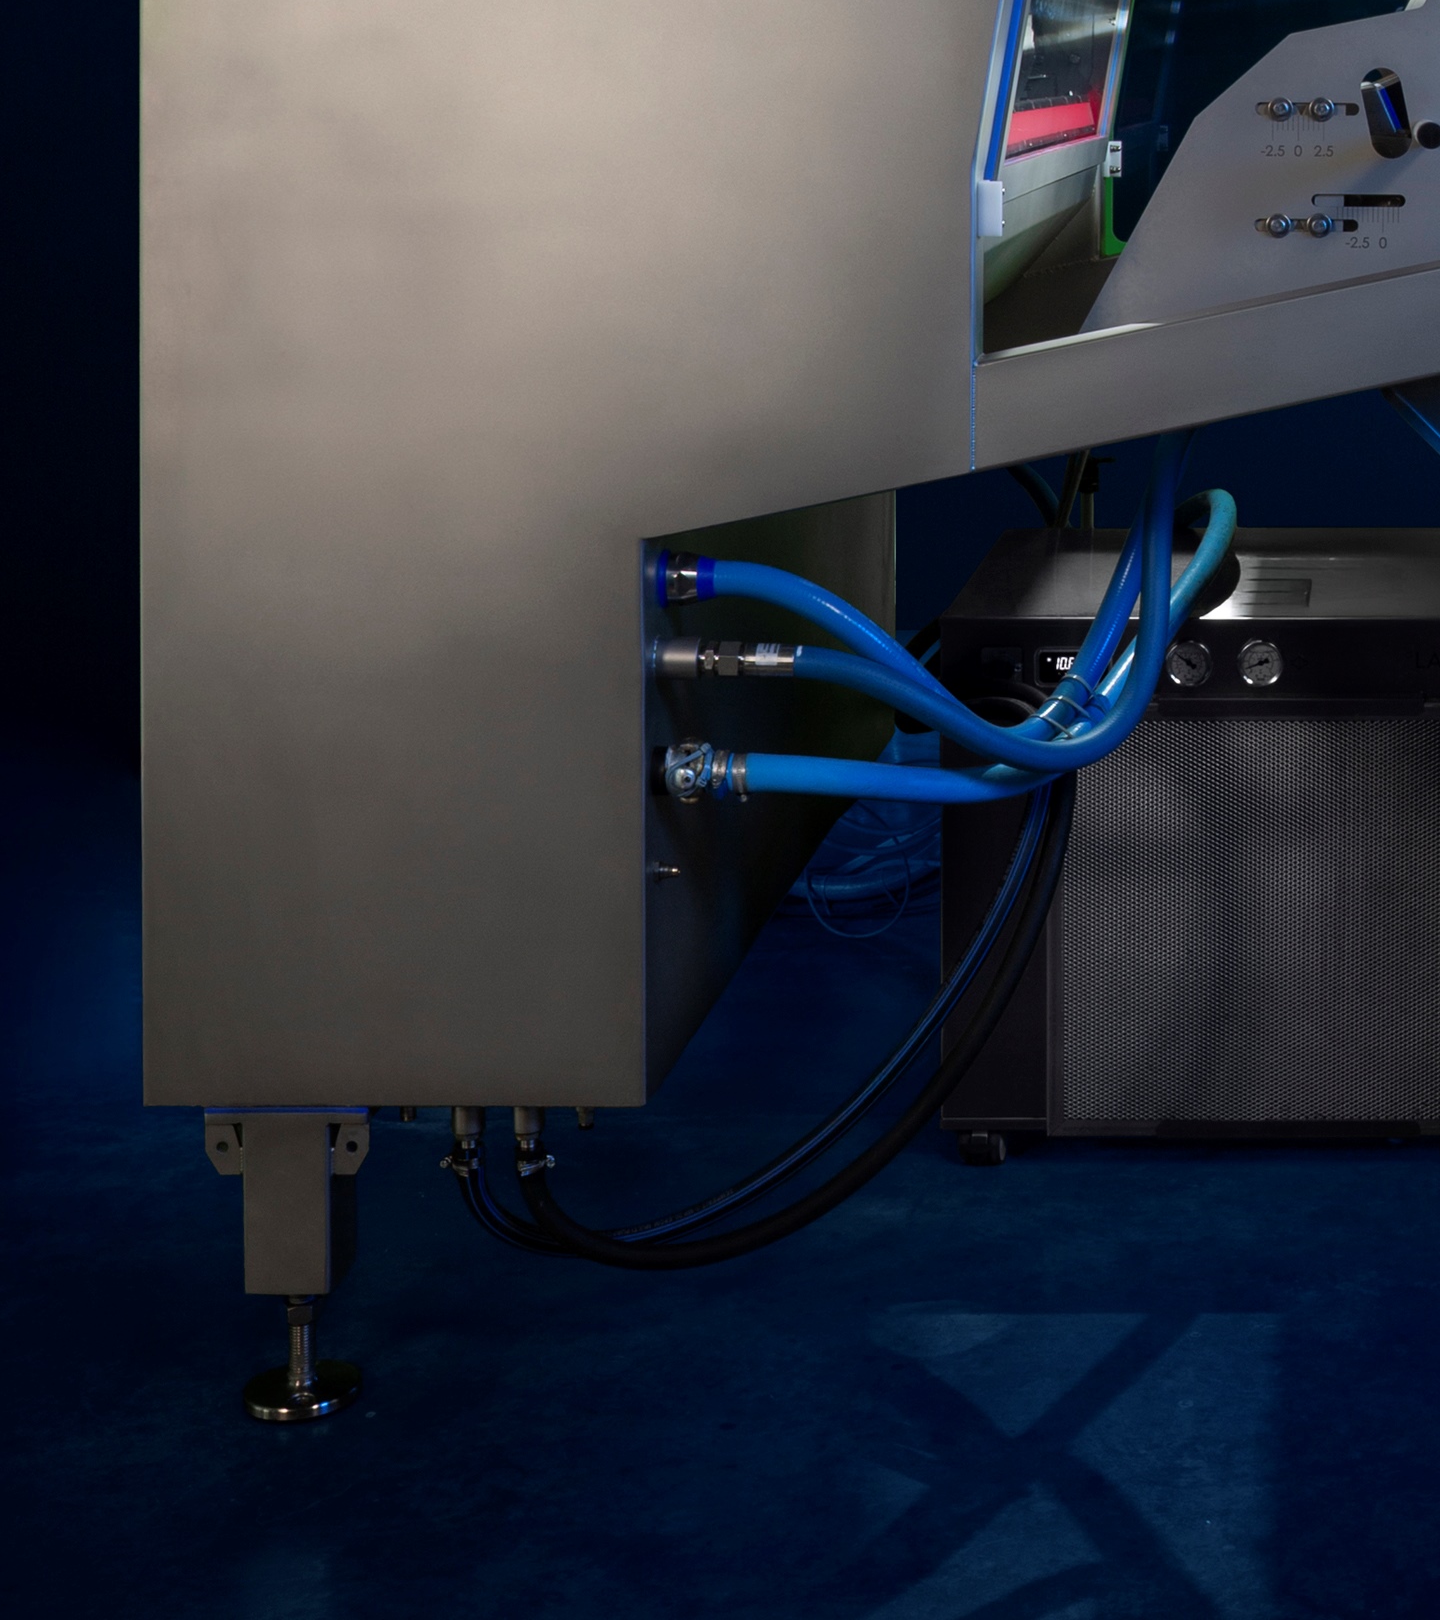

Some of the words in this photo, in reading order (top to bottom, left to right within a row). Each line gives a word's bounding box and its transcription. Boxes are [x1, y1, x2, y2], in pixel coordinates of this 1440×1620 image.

[1261, 145, 1285, 157] -2.5
[1294, 145, 1302, 157] 0
[1314, 145, 1334, 157] 2.5
[1345, 237, 1370, 249] -2.5
[1379, 237, 1387, 249] 0
